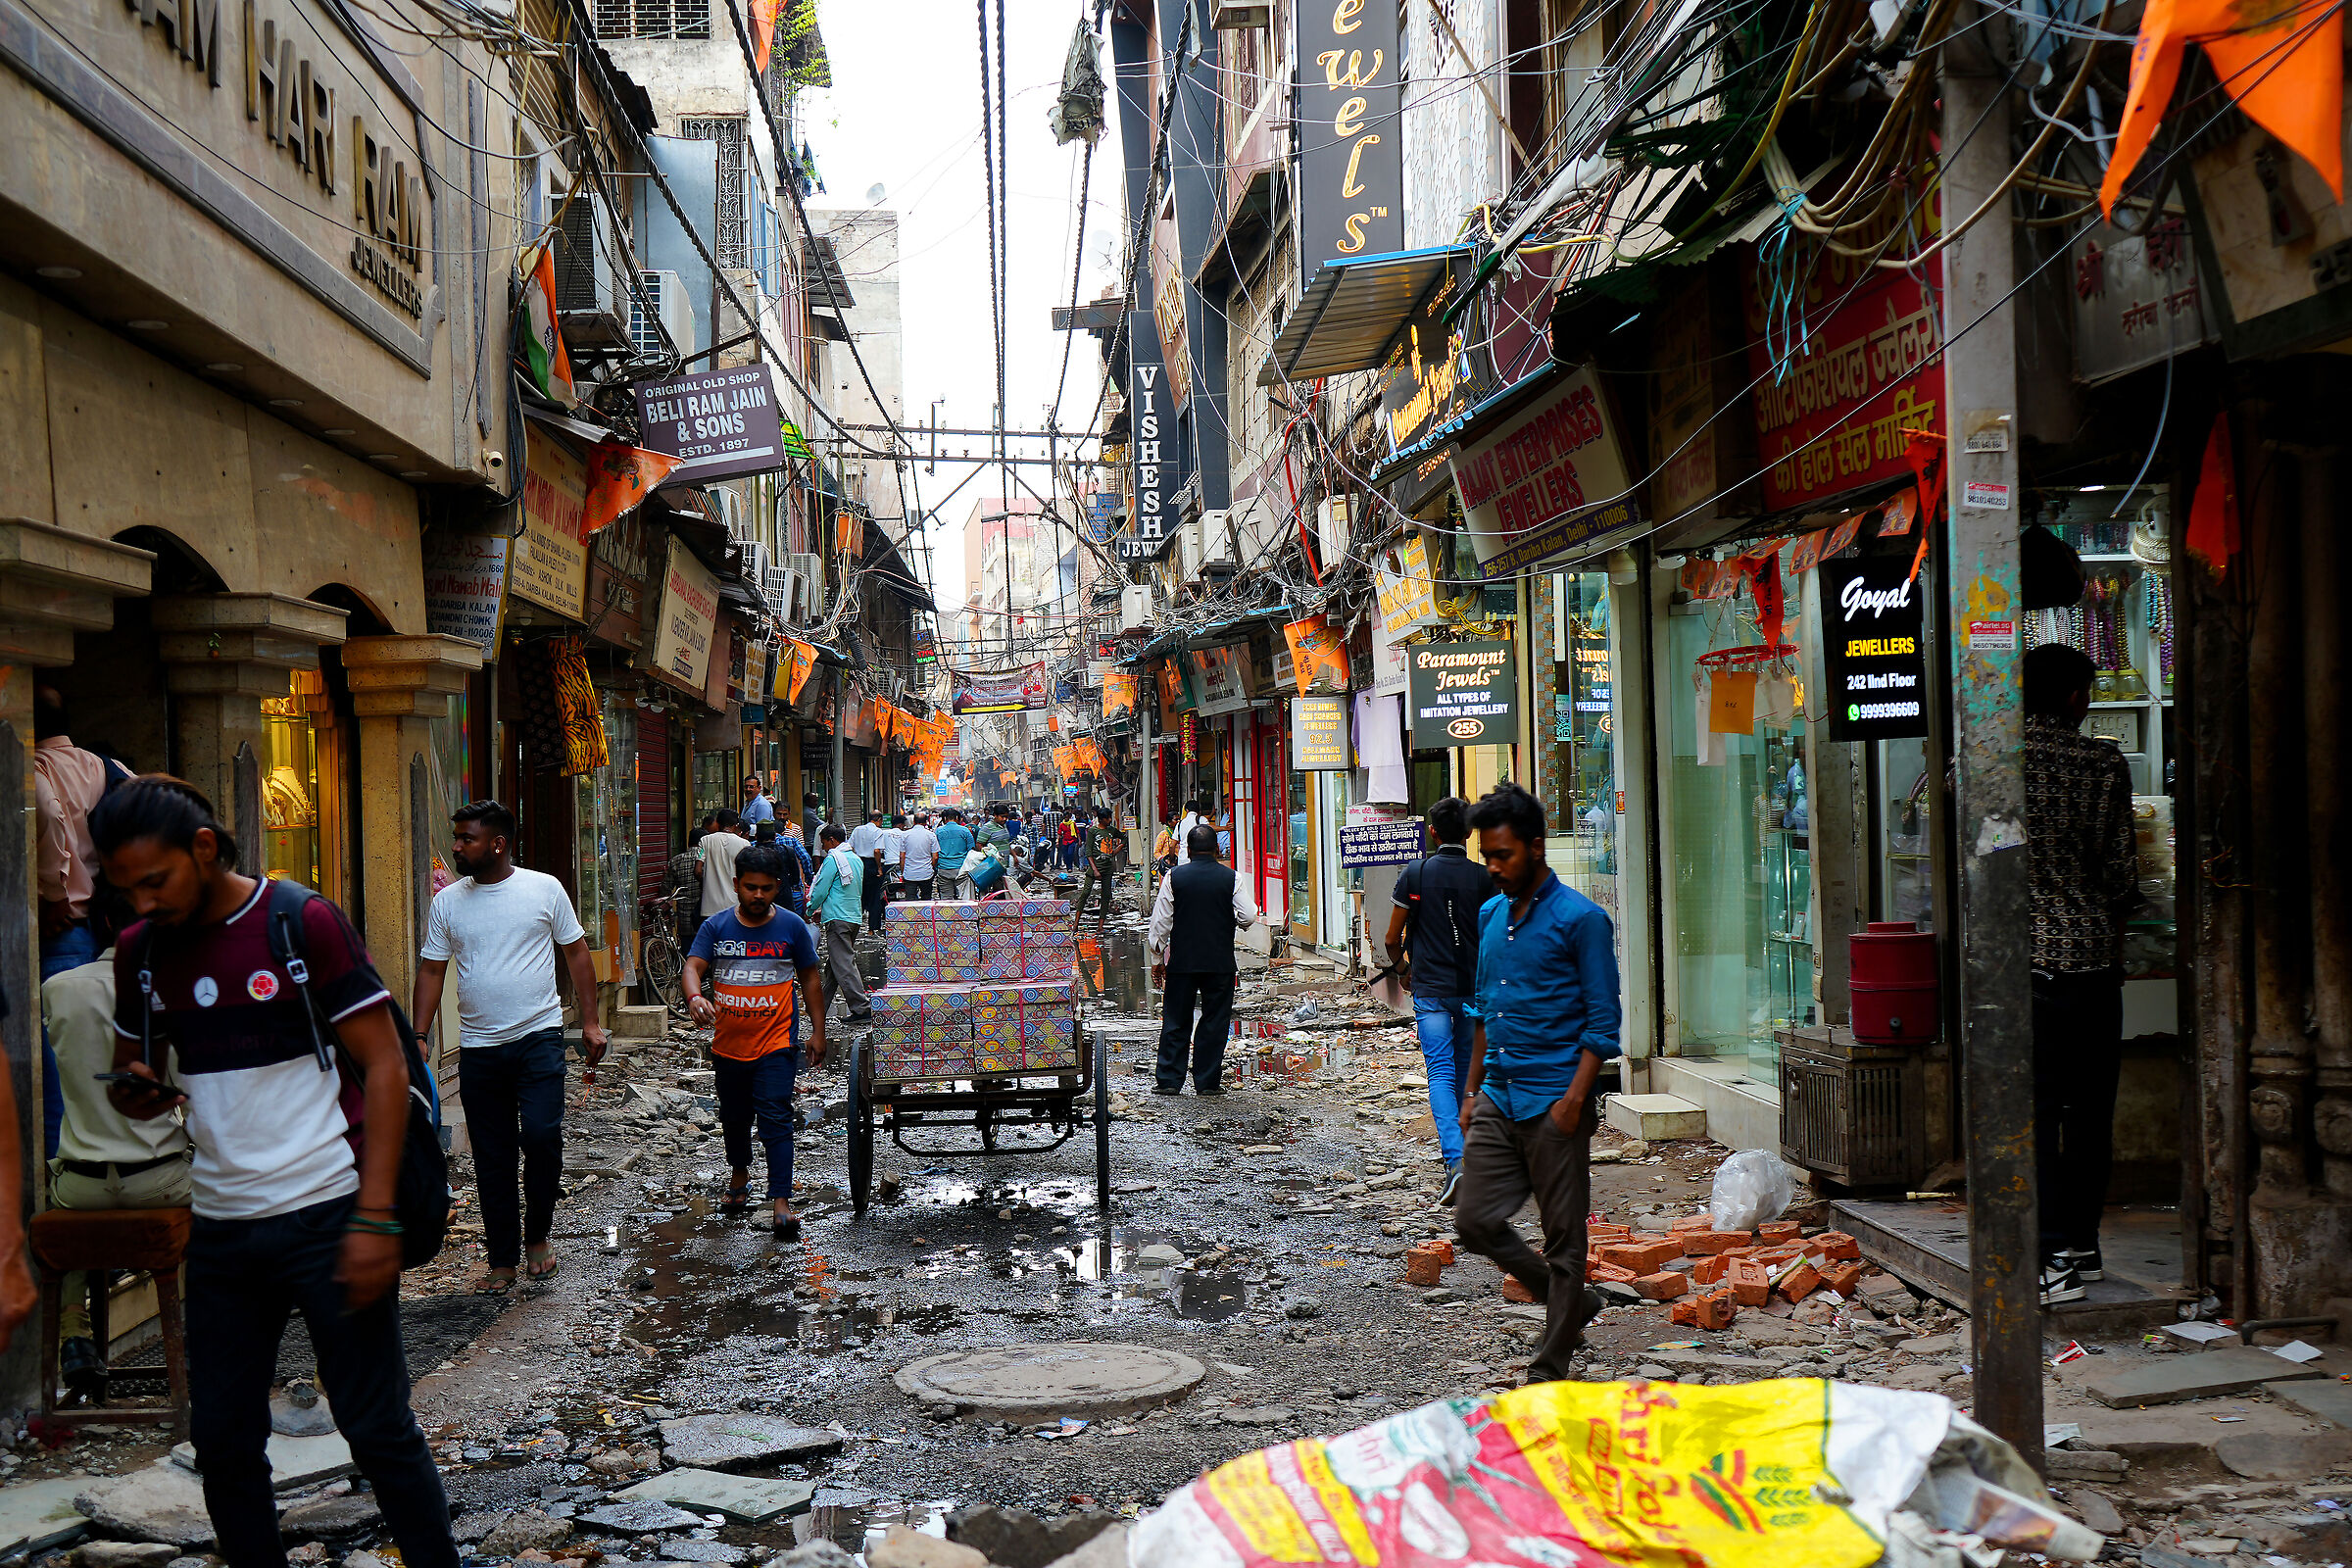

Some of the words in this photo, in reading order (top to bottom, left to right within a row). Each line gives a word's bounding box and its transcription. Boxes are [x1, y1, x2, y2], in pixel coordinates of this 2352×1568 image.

[244, 0, 337, 196] HARI
[353, 116, 422, 273] RAM
[351, 236, 423, 319] JEWELLERS
[645, 381, 701, 399] ORIGINAL
[703, 377, 726, 390] OLD
[729, 372, 760, 385] SHOP
[646, 398, 684, 424] BELI
[687, 392, 725, 416] RAM
[729, 386, 767, 411] JAIN
[677, 420, 692, 442] &
[695, 413, 746, 440] SONS
[678, 444, 715, 458] ESTD.
[719, 438, 749, 452] 1897
[1137, 366, 1163, 539] VISHESH
[1456, 450, 1501, 513] RAJAT
[1494, 384, 1604, 489] ENTERPRISES
[1835, 419, 1871, 476] सेल
[1494, 460, 1586, 547] JEWELLERS
[1520, 542, 1542, 562] Dariba
[1566, 520, 1589, 539] Delhi
[1593, 504, 1629, 530] 110006
[1122, 541, 1161, 559] JEW
[488, 564, 504, 574] 1660
[447, 574, 478, 596] Nawab
[480, 576, 503, 598] Wali
[440, 600, 466, 612] DARIBA
[468, 602, 497, 614] KALAN
[1840, 576, 1910, 621] Goyal
[430, 612, 464, 623] CHANDNI
[464, 613, 491, 626] CHOWK
[438, 624, 464, 636] DELHI
[1845, 637, 1915, 657] JEWELLERS
[1416, 649, 1506, 668] Paramount
[1846, 674, 1866, 690] 242
[1888, 672, 1916, 688] Floor
[1436, 694, 1452, 705] ALL
[1452, 692, 1478, 704] TYPES
[1478, 691, 1491, 702] OF
[1420, 706, 1461, 718] IMITATION
[1461, 704, 1508, 716] JEWELLERY
[1860, 702, 1919, 719] 9999396609
[1303, 721, 1337, 730] JEWELLERS
[1453, 722, 1478, 735] 255
[1309, 733, 1333, 744] 92.5
[1301, 755, 1342, 763] JEWELLERY
[1302, 746, 1341, 755] HALLMARK
[1379, 831, 1391, 840] दाम
[1358, 844, 1370, 853] भाव
[1371, 842, 1378, 853] से
[1378, 840, 1396, 853] खरीदा
[1396, 842, 1411, 851] जाता
[1412, 838, 1418, 850] है
[1396, 852, 1402, 860] भी
[1417, 850, 1423, 859] है
